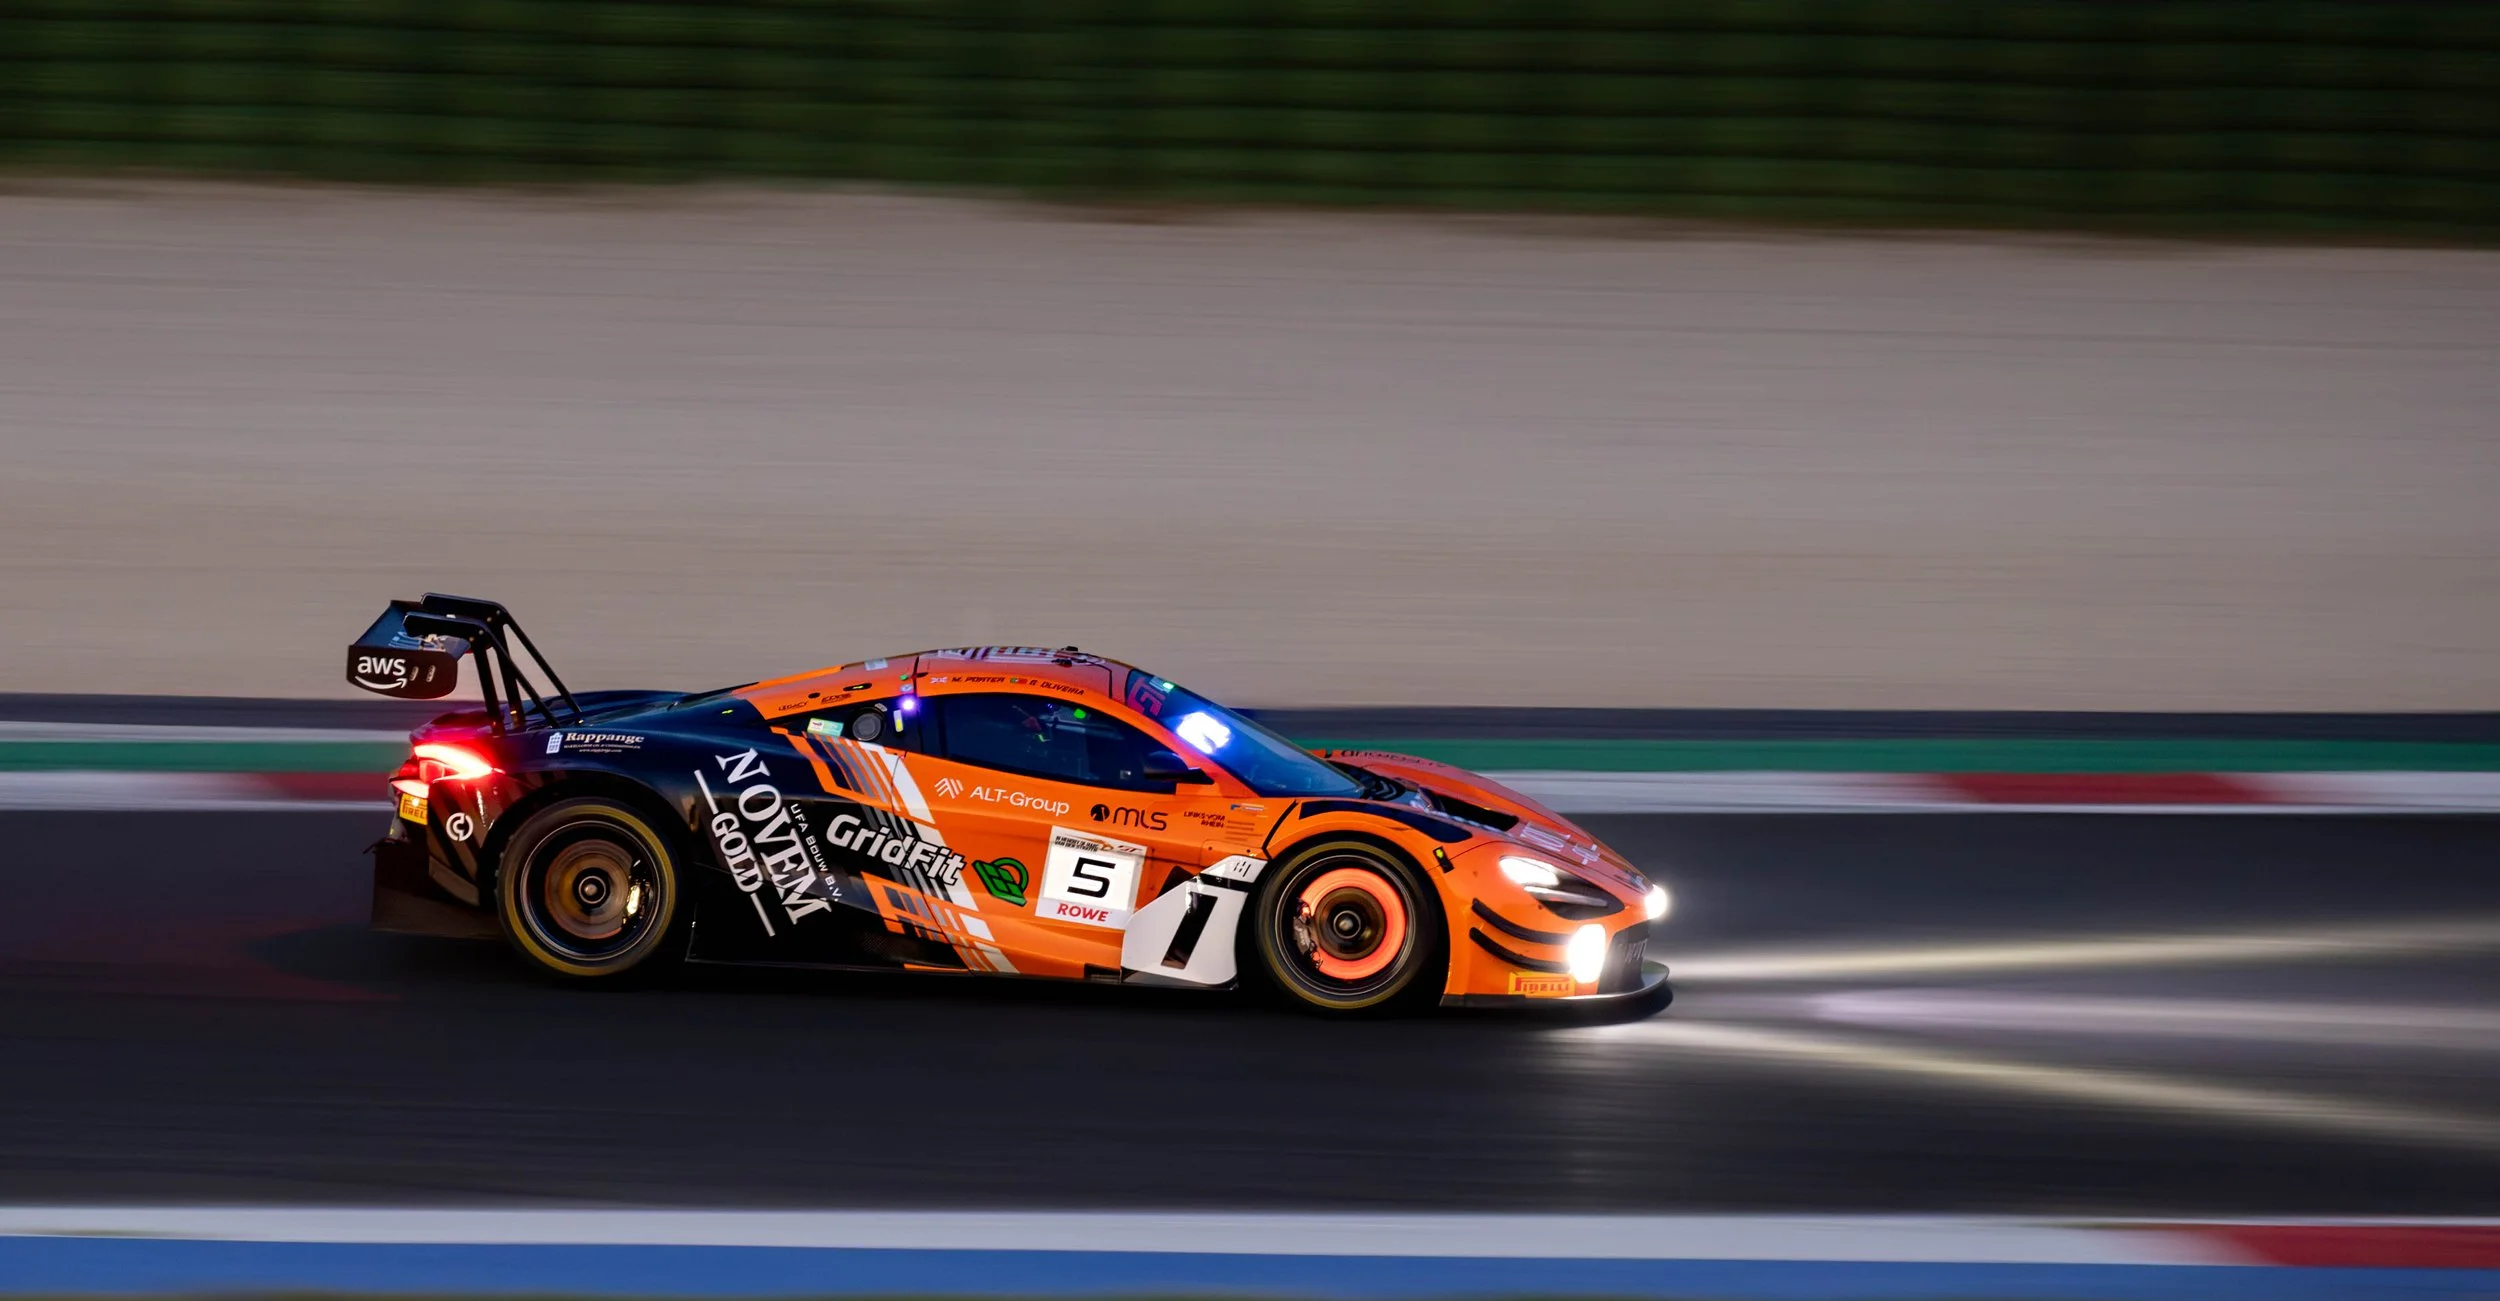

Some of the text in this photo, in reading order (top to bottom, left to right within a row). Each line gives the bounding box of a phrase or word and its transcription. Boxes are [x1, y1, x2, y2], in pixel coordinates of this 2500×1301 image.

[357, 656, 406, 676] aws
[1040, 681, 1085, 696] OLIVEIRA
[565, 732, 645, 745] Rappange
[970, 785, 1070, 816] ALT-Group
[790, 803, 809, 833] UFA
[715, 748, 832, 924] NOVEM
[826, 813, 967, 885] GridFit
[711, 813, 765, 892] GOLD
[1067, 857, 1116, 898] 5
[1056, 903, 1109, 922] ROWE
